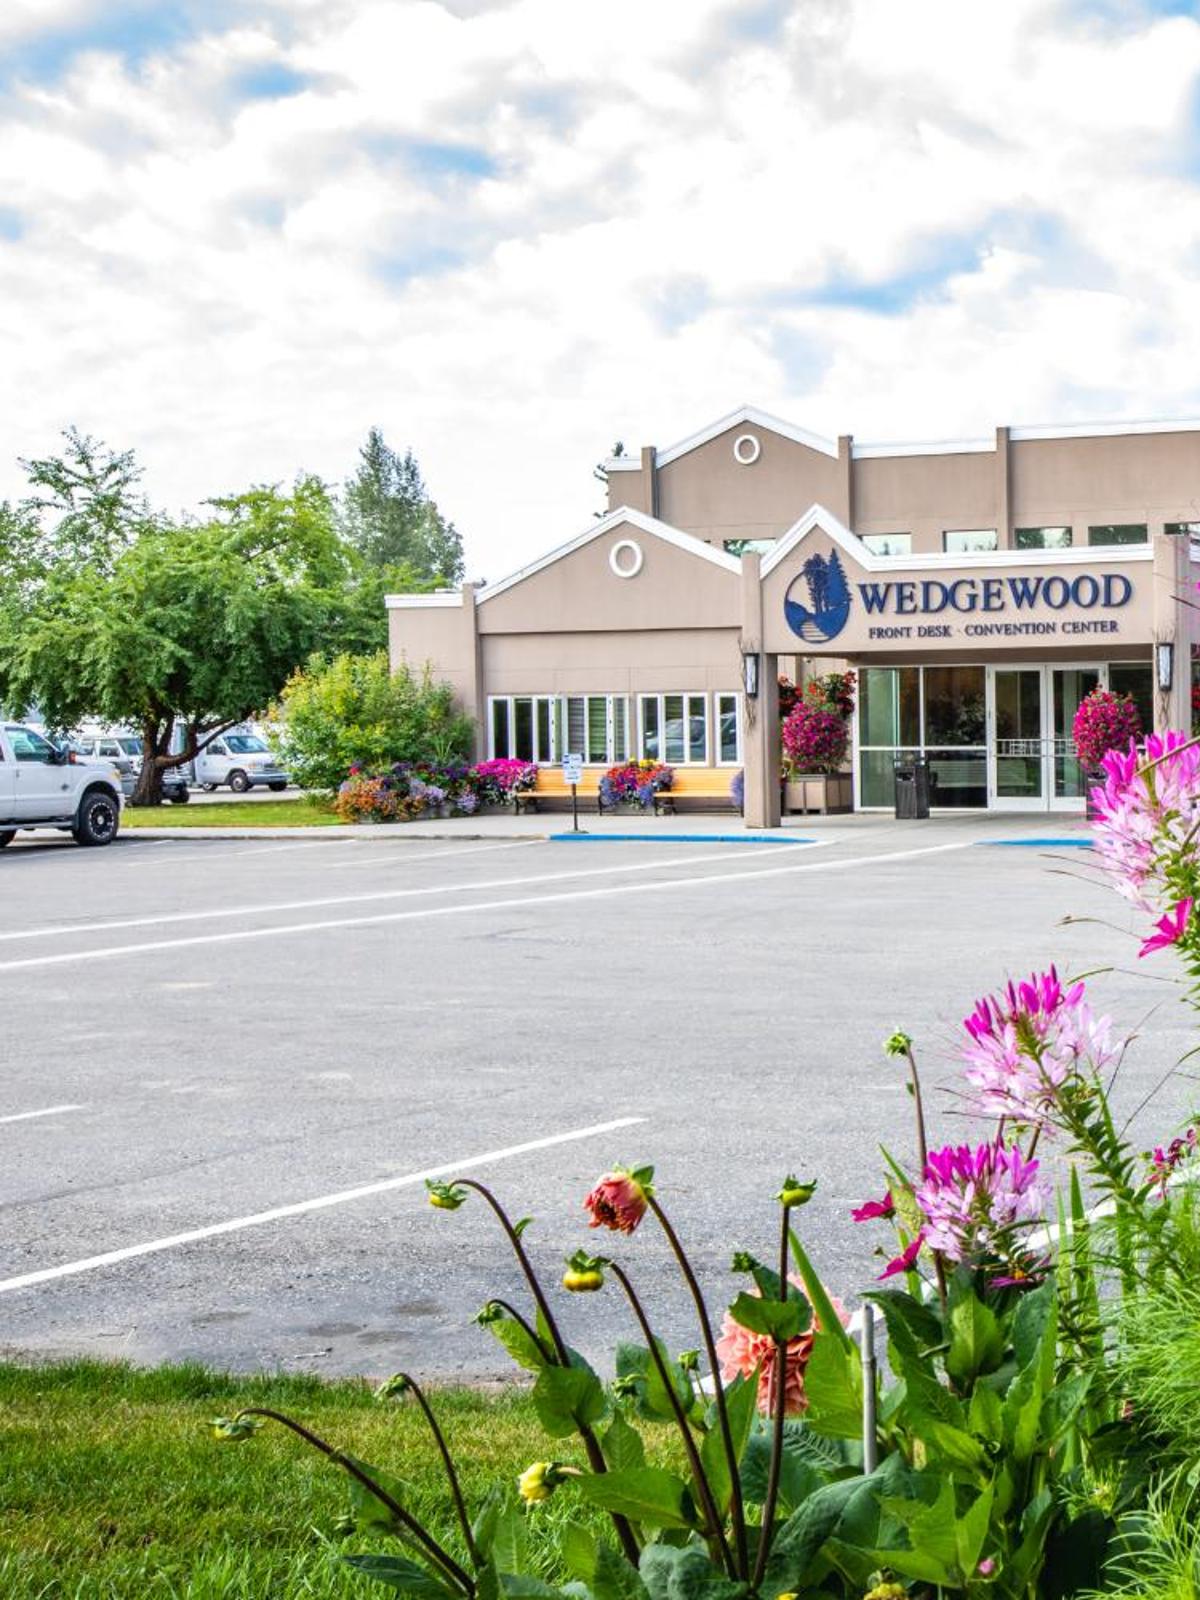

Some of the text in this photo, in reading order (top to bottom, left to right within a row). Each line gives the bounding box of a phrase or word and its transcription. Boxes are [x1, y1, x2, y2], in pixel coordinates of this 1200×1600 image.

[857, 574, 1134, 615] WEDGEWOOD
[868, 620, 1119, 640] FRONT DESK CONVENTION CENTER
